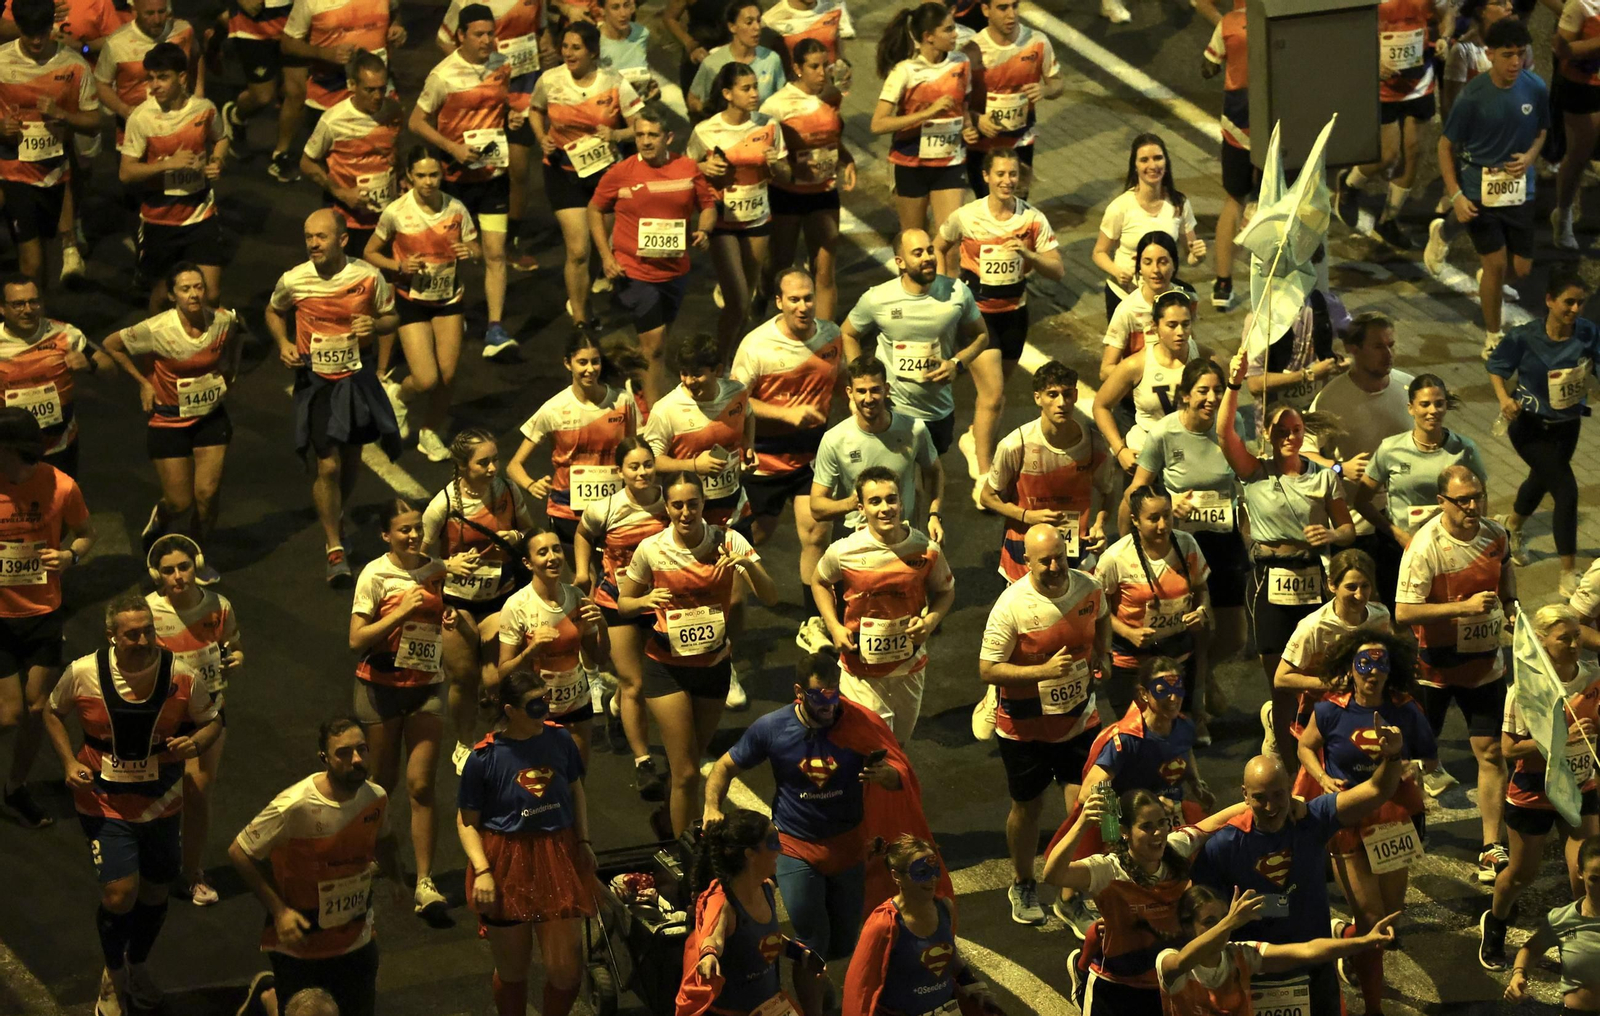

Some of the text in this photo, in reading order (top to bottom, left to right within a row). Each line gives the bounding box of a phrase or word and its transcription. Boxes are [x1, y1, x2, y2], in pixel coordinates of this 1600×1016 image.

[1389, 45, 1416, 60] 3783
[926, 134, 959, 147] 17947
[579, 145, 607, 165] 7197
[1487, 181, 1520, 195] 20807
[729, 197, 764, 211] 21764
[643, 234, 679, 248] 20388
[985, 259, 1021, 274] 22051
[316, 349, 354, 363] 15575
[185, 386, 221, 405] 14407
[576, 483, 617, 498] 13163
[0, 558, 40, 574] 13940
[1275, 576, 1315, 592] 14014
[680, 624, 714, 643] 6623
[1464, 621, 1499, 641] 24012
[408, 641, 436, 659] 9363
[866, 635, 907, 651] 12312
[549, 681, 583, 701] 12313
[1050, 681, 1082, 702] 6625
[1373, 834, 1414, 860] 10540
[325, 891, 365, 915] 21205
